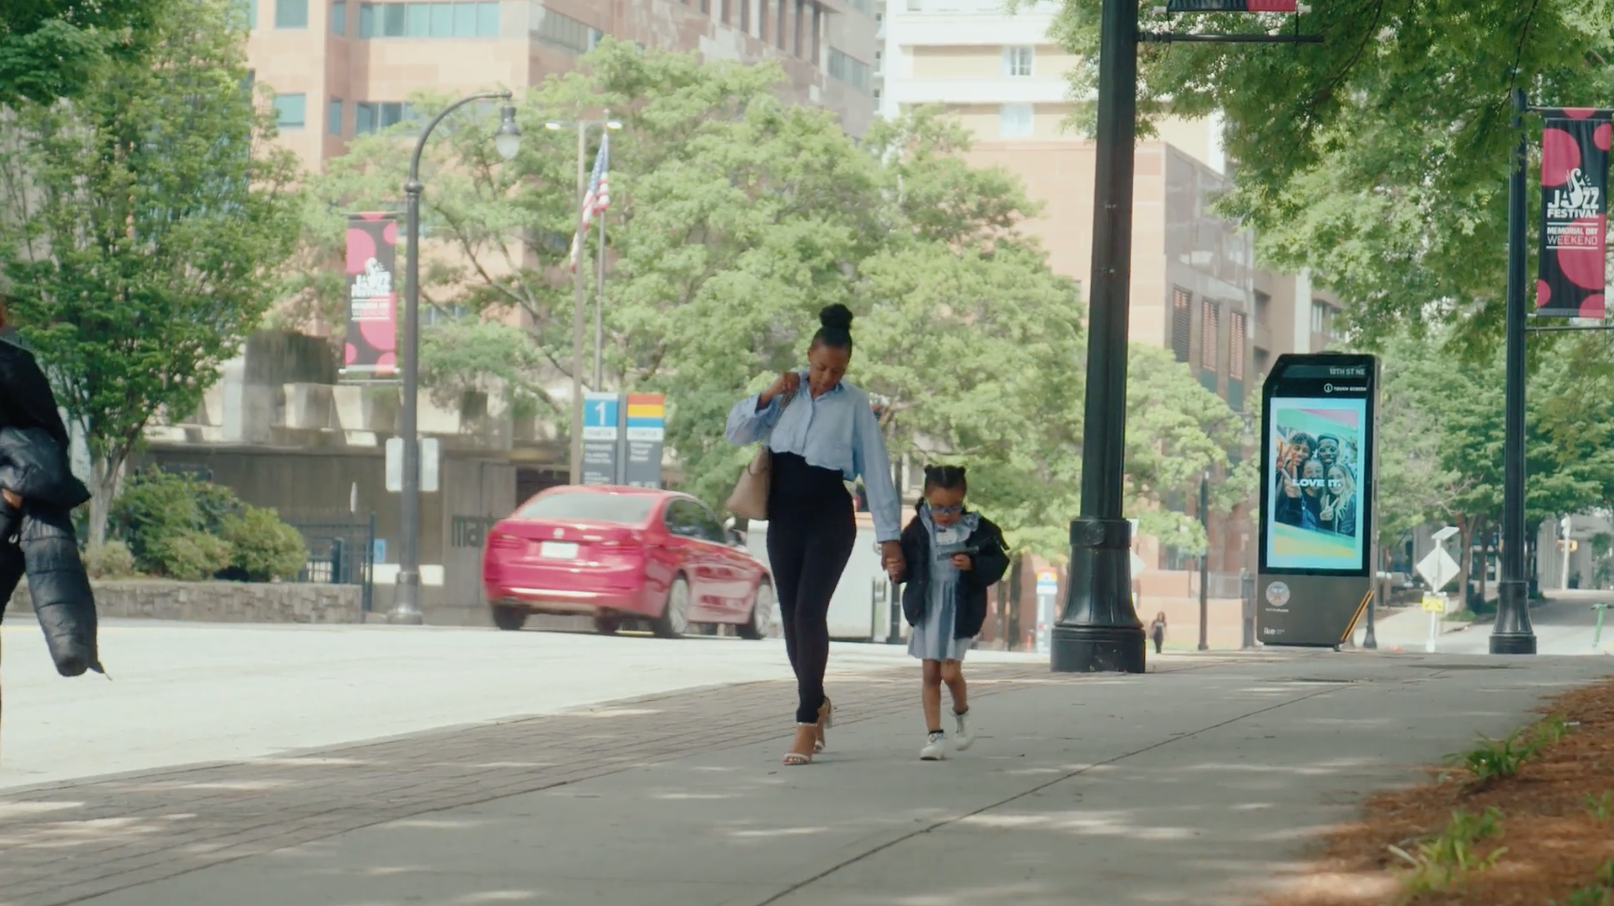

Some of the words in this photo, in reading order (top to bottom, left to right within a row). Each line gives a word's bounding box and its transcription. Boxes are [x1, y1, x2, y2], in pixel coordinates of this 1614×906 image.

[1547, 178, 1599, 209] JAZZ
[1547, 209, 1599, 218] FESTIVAL
[1547, 227, 1583, 235] MEMORIAL
[1585, 227, 1599, 235] DAY
[1547, 235, 1598, 245] WEEKEND
[594, 401, 606, 427] 1
[1292, 479, 1325, 487] LOVE
[1327, 479, 1342, 487] IT.
